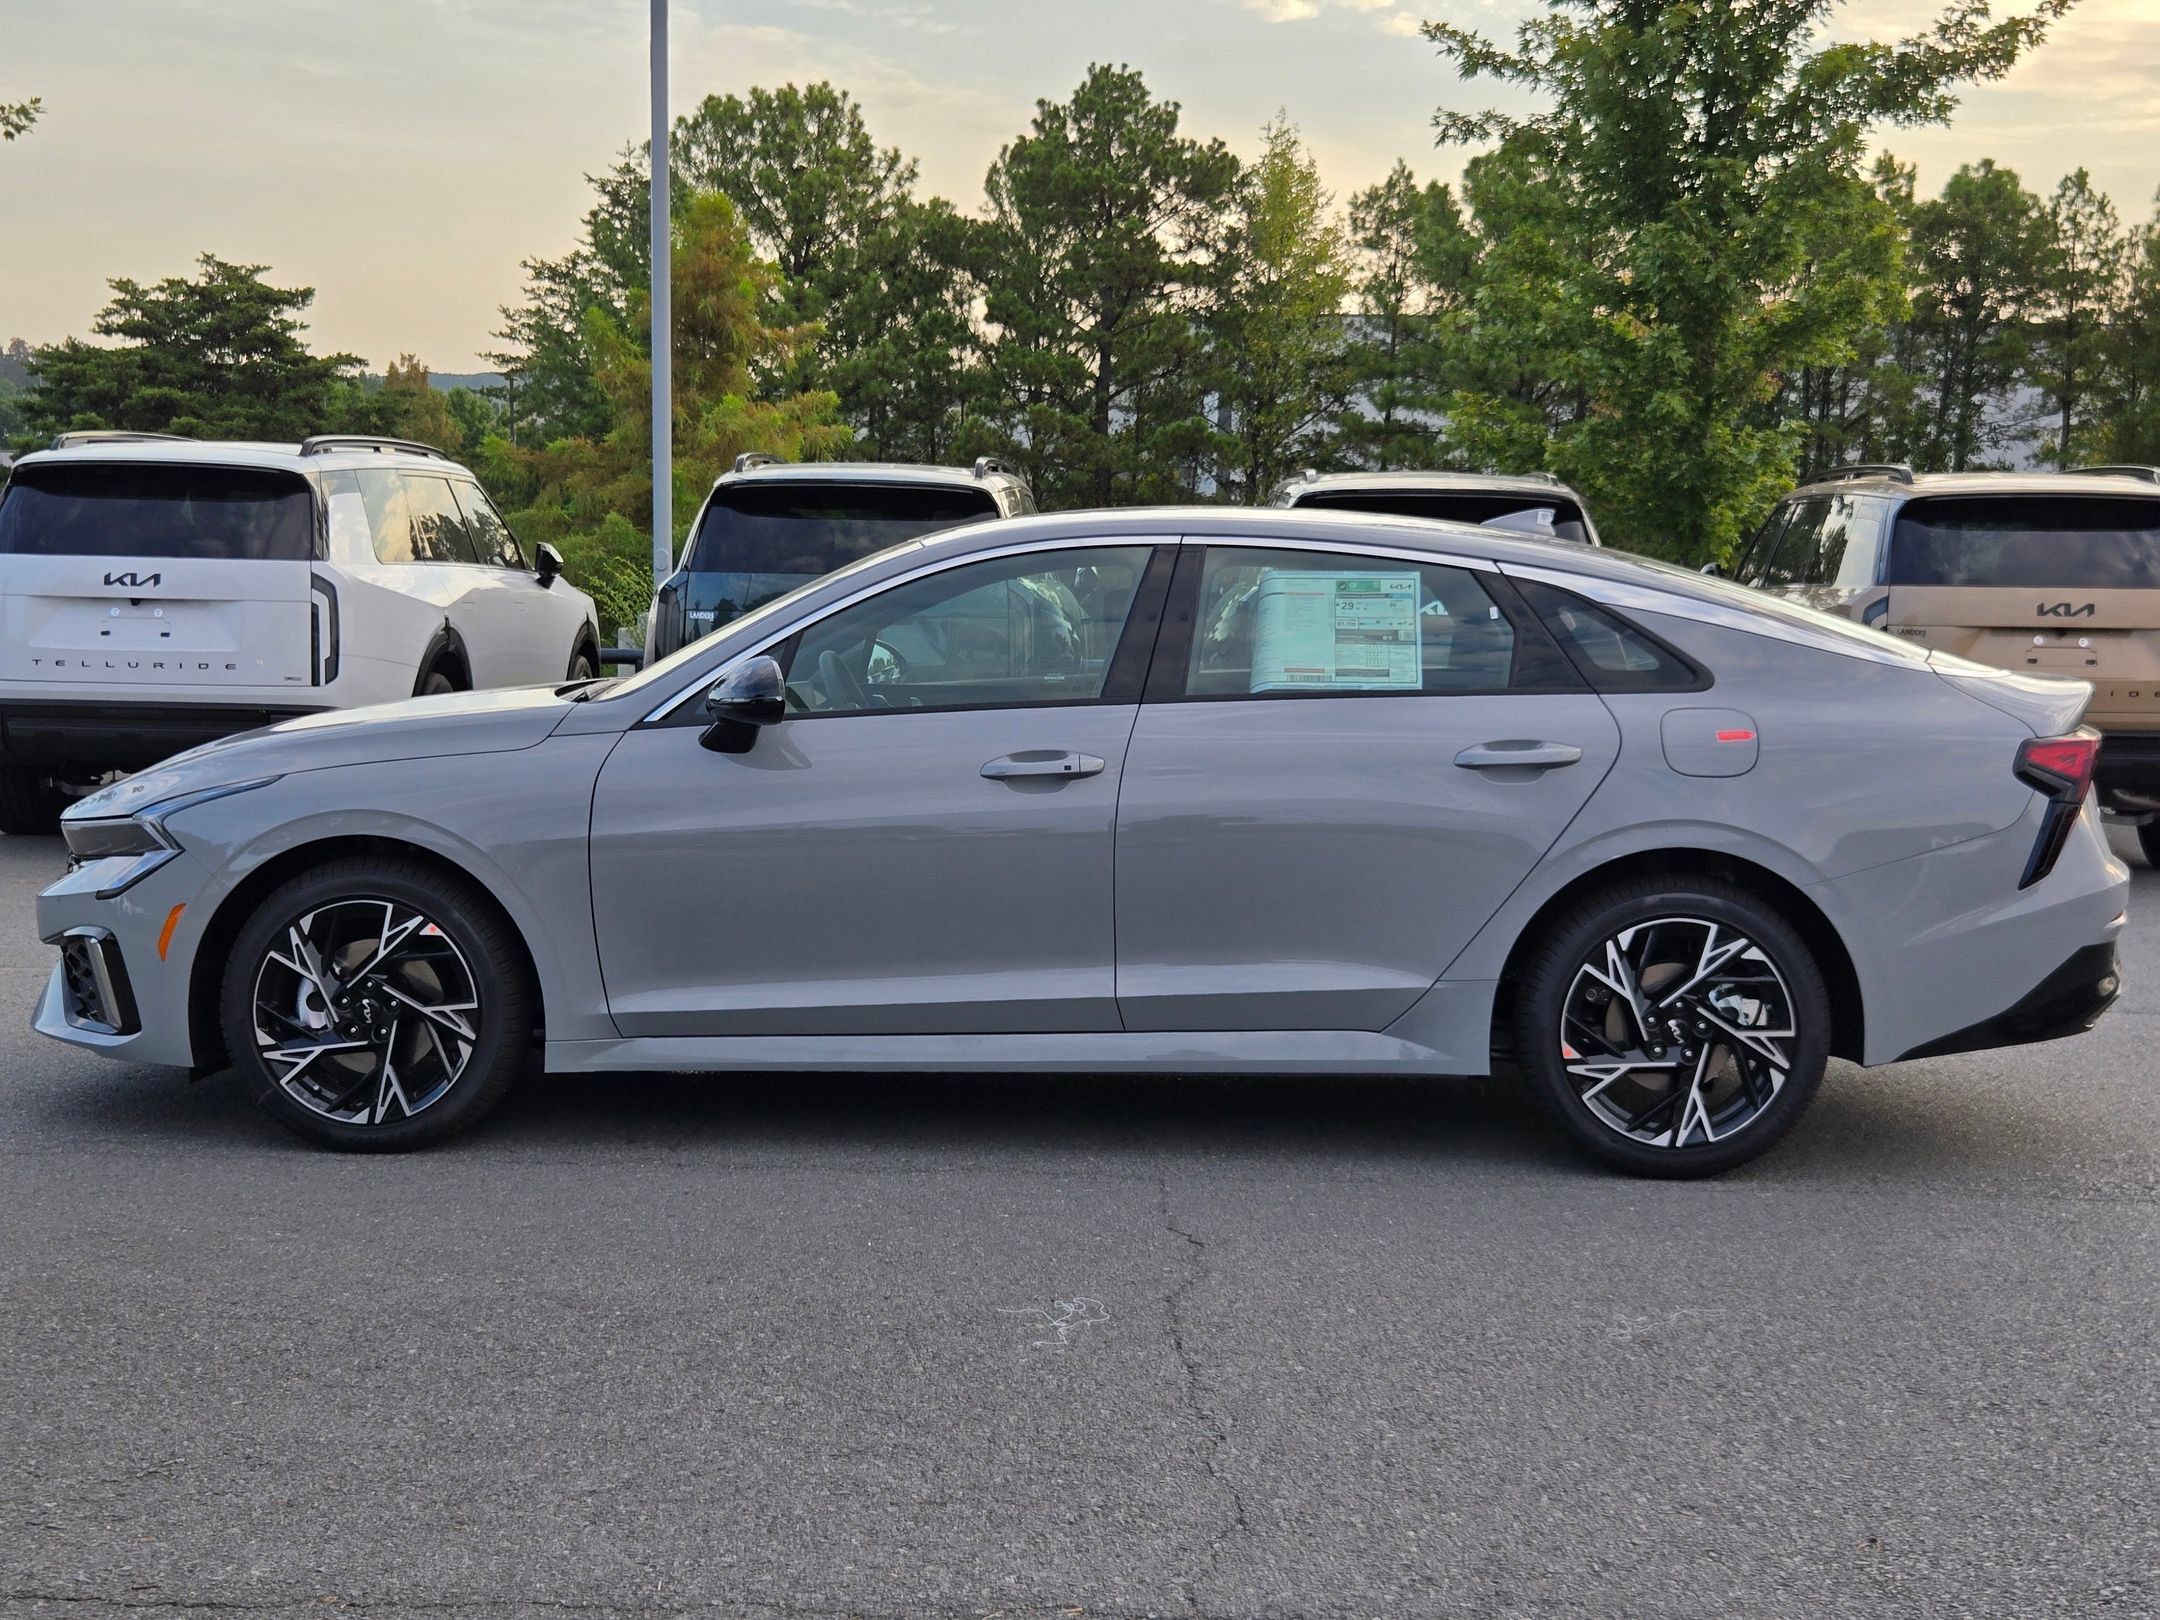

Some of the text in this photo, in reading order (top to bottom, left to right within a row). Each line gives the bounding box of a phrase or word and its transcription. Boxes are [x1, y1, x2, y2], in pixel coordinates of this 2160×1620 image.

[103, 572, 161, 587] KIA
[1341, 602, 1354, 611] 29
[2036, 602, 2095, 617] KIA
[32, 659, 236, 670] TELLURIDE
